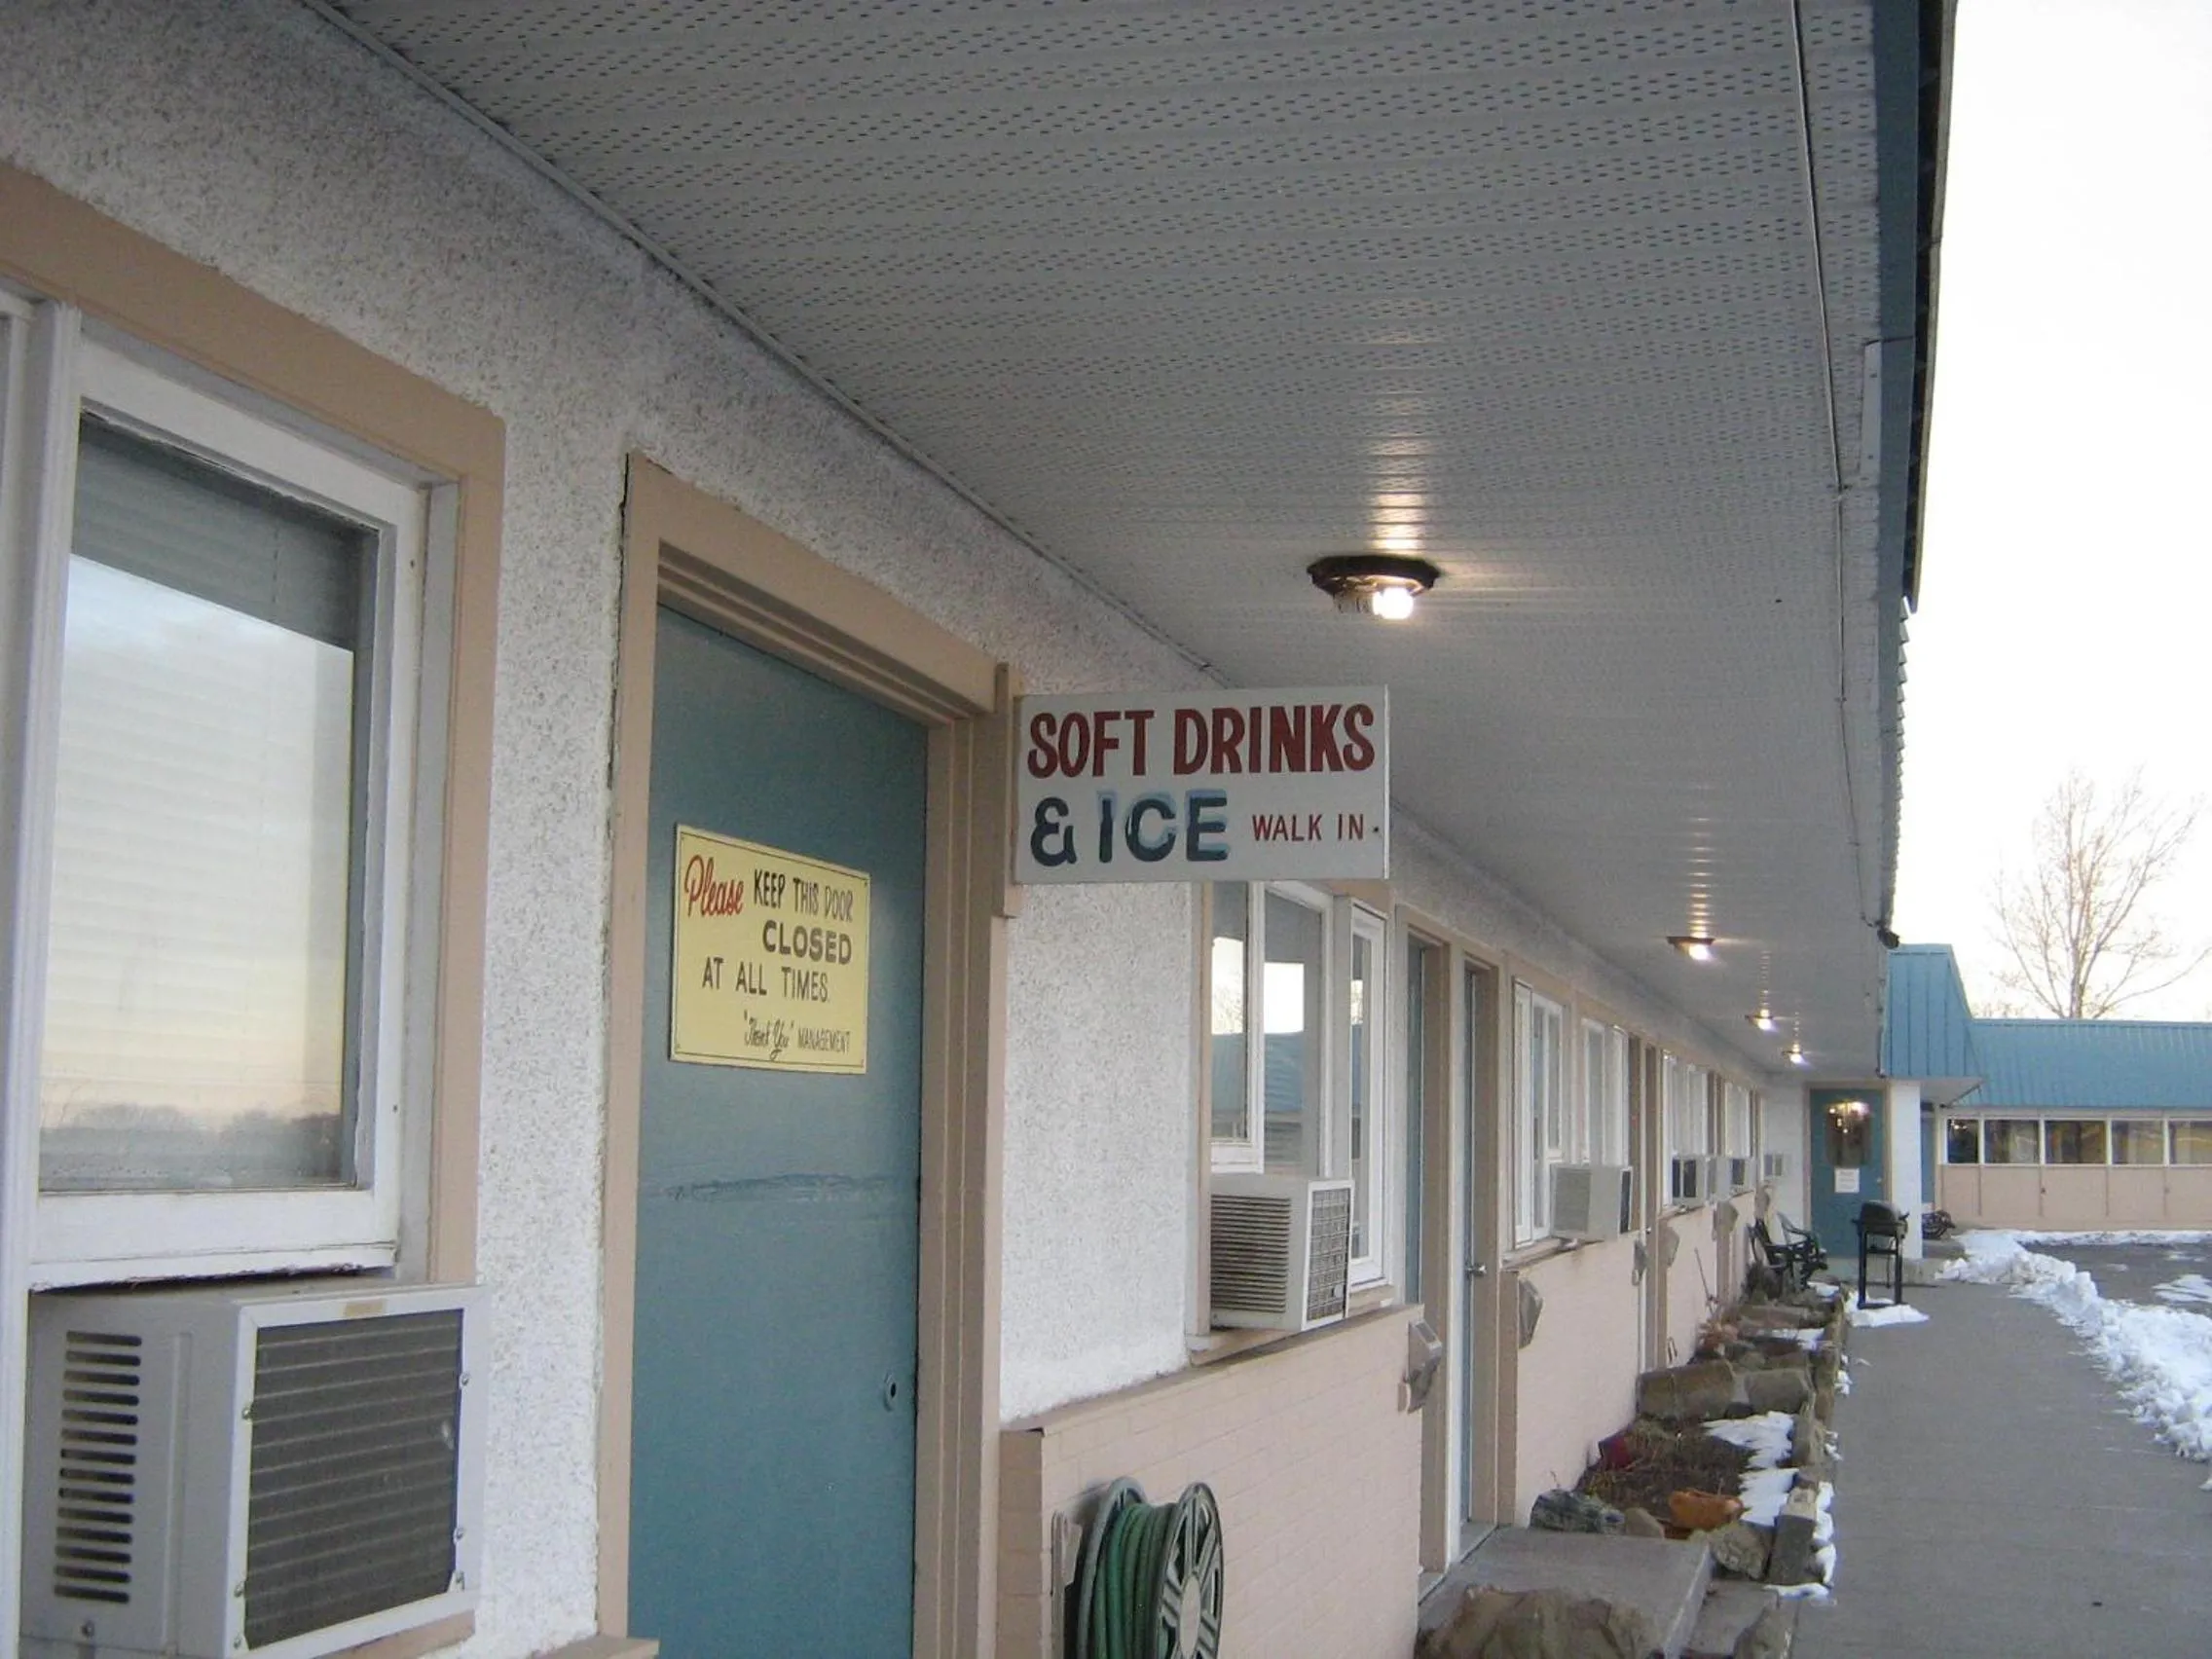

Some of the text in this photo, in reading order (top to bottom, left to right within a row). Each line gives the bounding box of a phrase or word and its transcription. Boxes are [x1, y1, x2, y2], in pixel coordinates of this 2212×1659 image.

[1027, 703, 1376, 778] SOFT DRINKS
[1030, 796, 1078, 866] &
[1097, 790, 1230, 863] ICE
[1252, 813, 1322, 841] WALK
[684, 855, 854, 923] Please KEEP THIS DOOR
[762, 920, 852, 965] CLOSED
[702, 956, 724, 990] AT
[735, 961, 767, 995] ALL
[797, 1026, 851, 1055] MANAGEMENT
